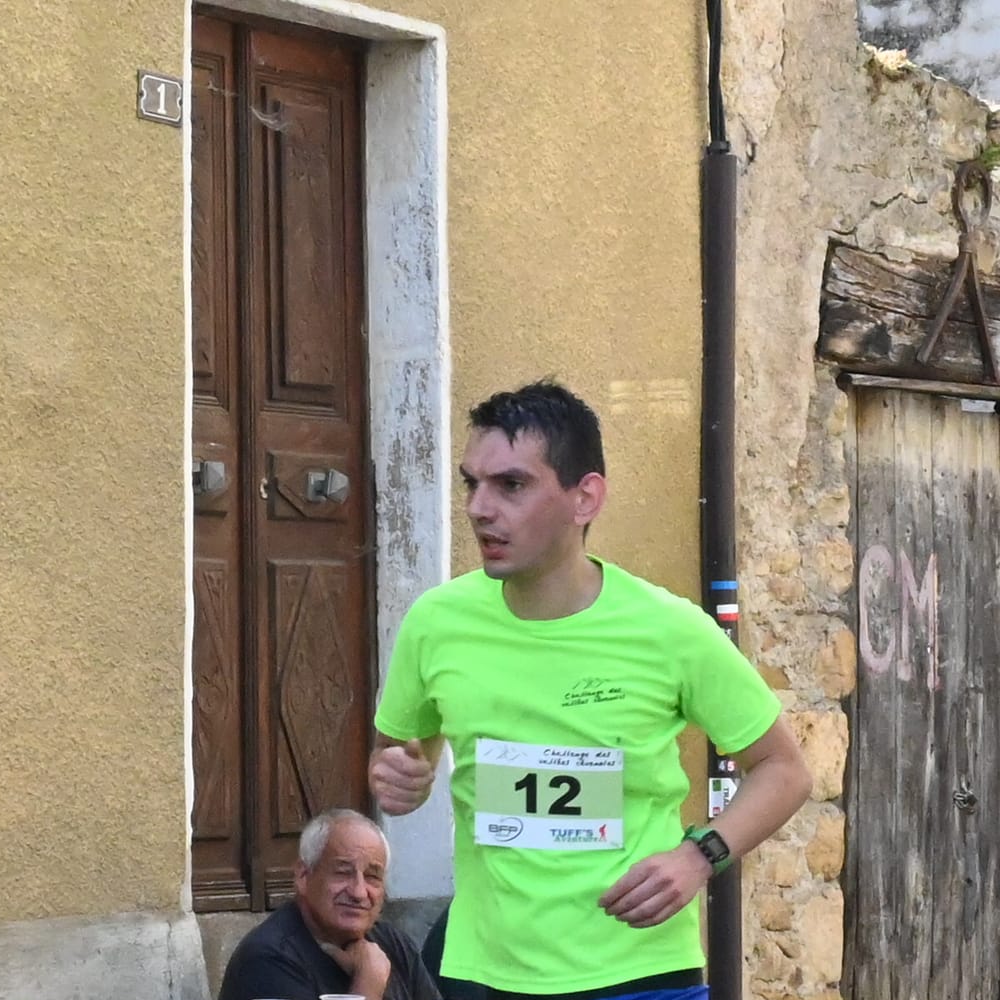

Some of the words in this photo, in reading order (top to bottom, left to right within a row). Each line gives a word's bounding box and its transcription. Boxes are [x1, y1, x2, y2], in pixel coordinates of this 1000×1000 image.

[157, 83, 167, 114] 1
[514, 773, 581, 816] 12
[488, 824, 518, 833] BFP
[549, 828, 594, 837] TUFF'S
